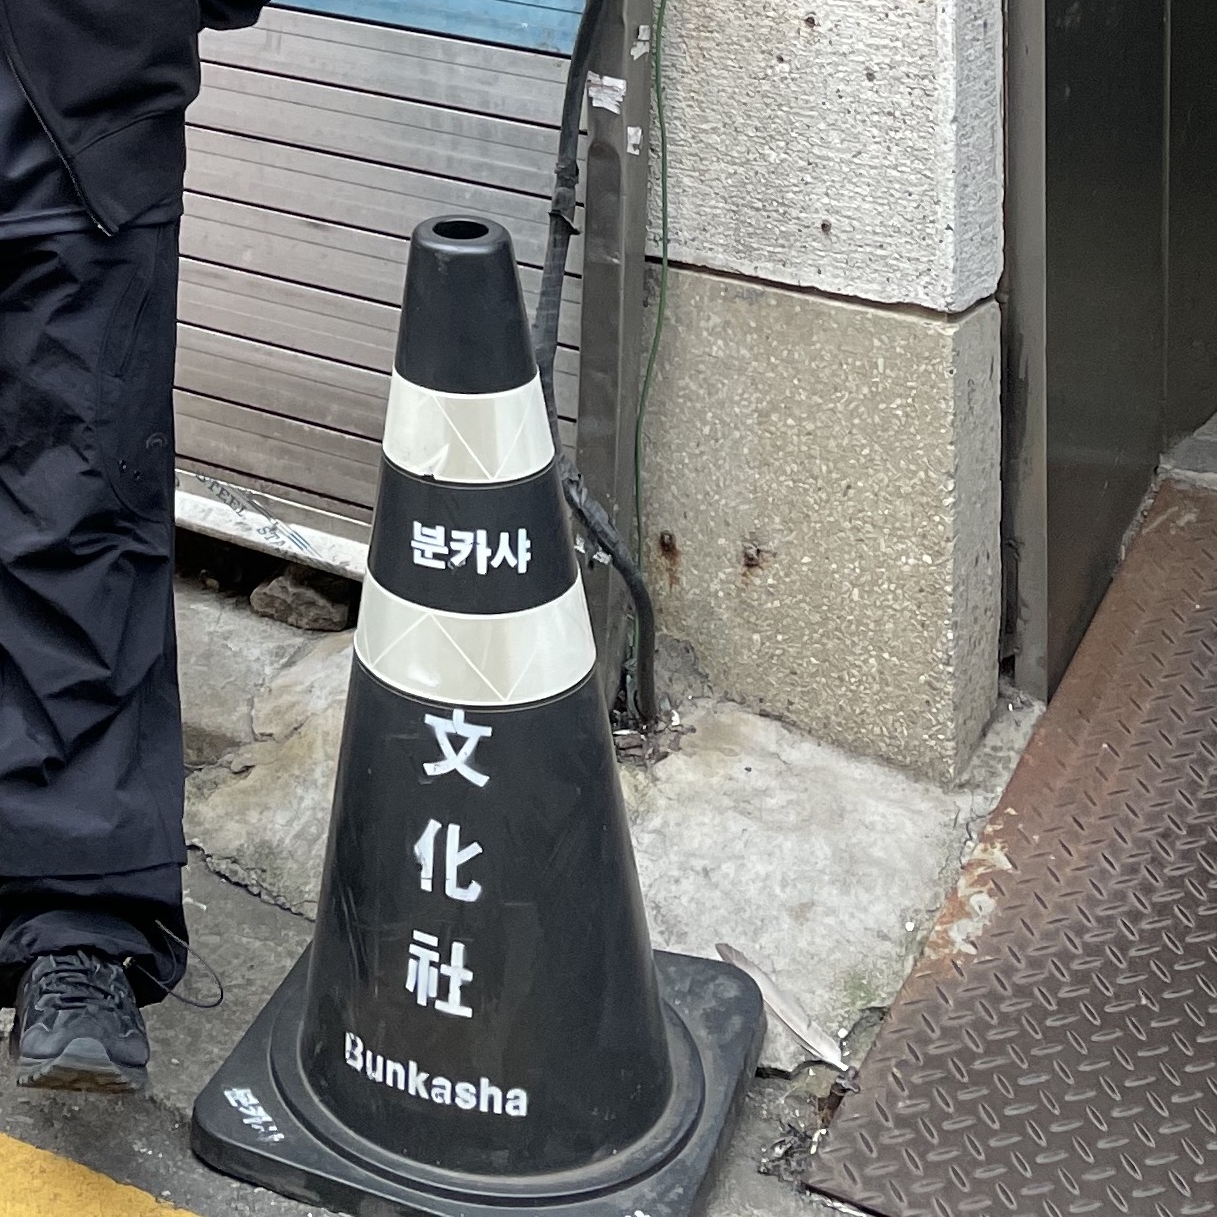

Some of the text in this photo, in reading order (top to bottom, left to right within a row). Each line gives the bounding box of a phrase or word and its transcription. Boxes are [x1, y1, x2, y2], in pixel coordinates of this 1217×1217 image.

[410, 520, 532, 575] 분카샤
[405, 708, 492, 1018] 文化社
[345, 1031, 528, 1117] Bunkasha
